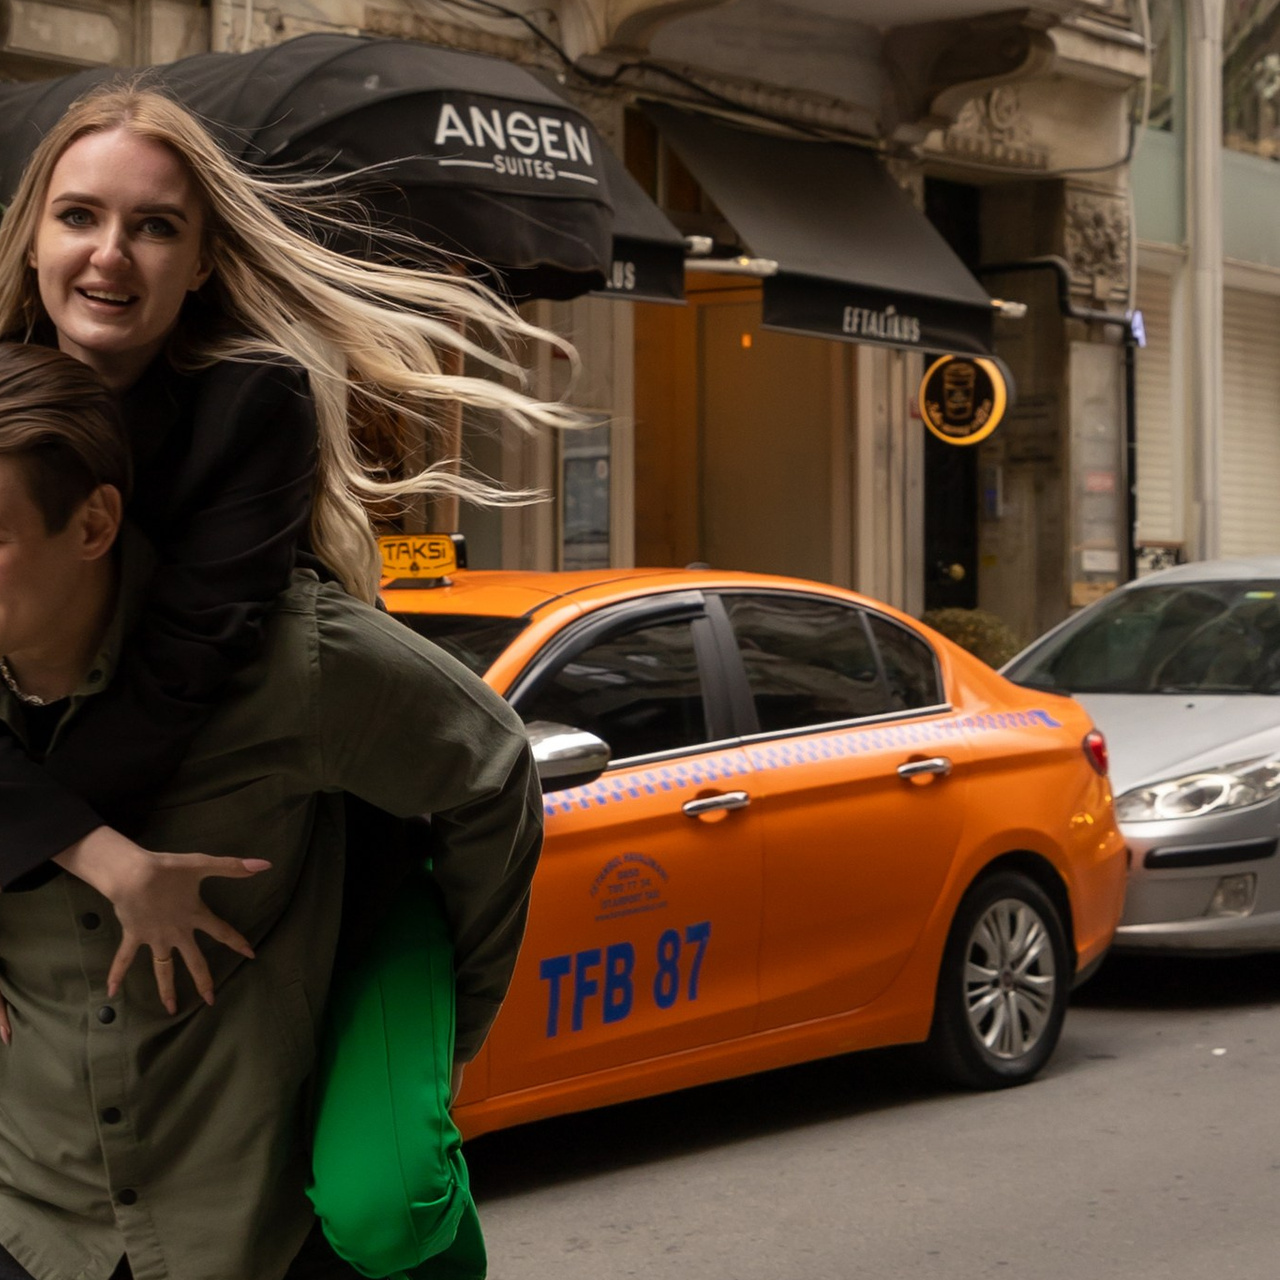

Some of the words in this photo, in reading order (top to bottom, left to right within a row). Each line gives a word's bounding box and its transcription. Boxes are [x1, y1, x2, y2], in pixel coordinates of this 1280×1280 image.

[434, 103, 593, 166] ANSEN
[493, 154, 556, 181] SUITES
[539, 941, 636, 1039] TFB
[653, 920, 713, 1010] 87
